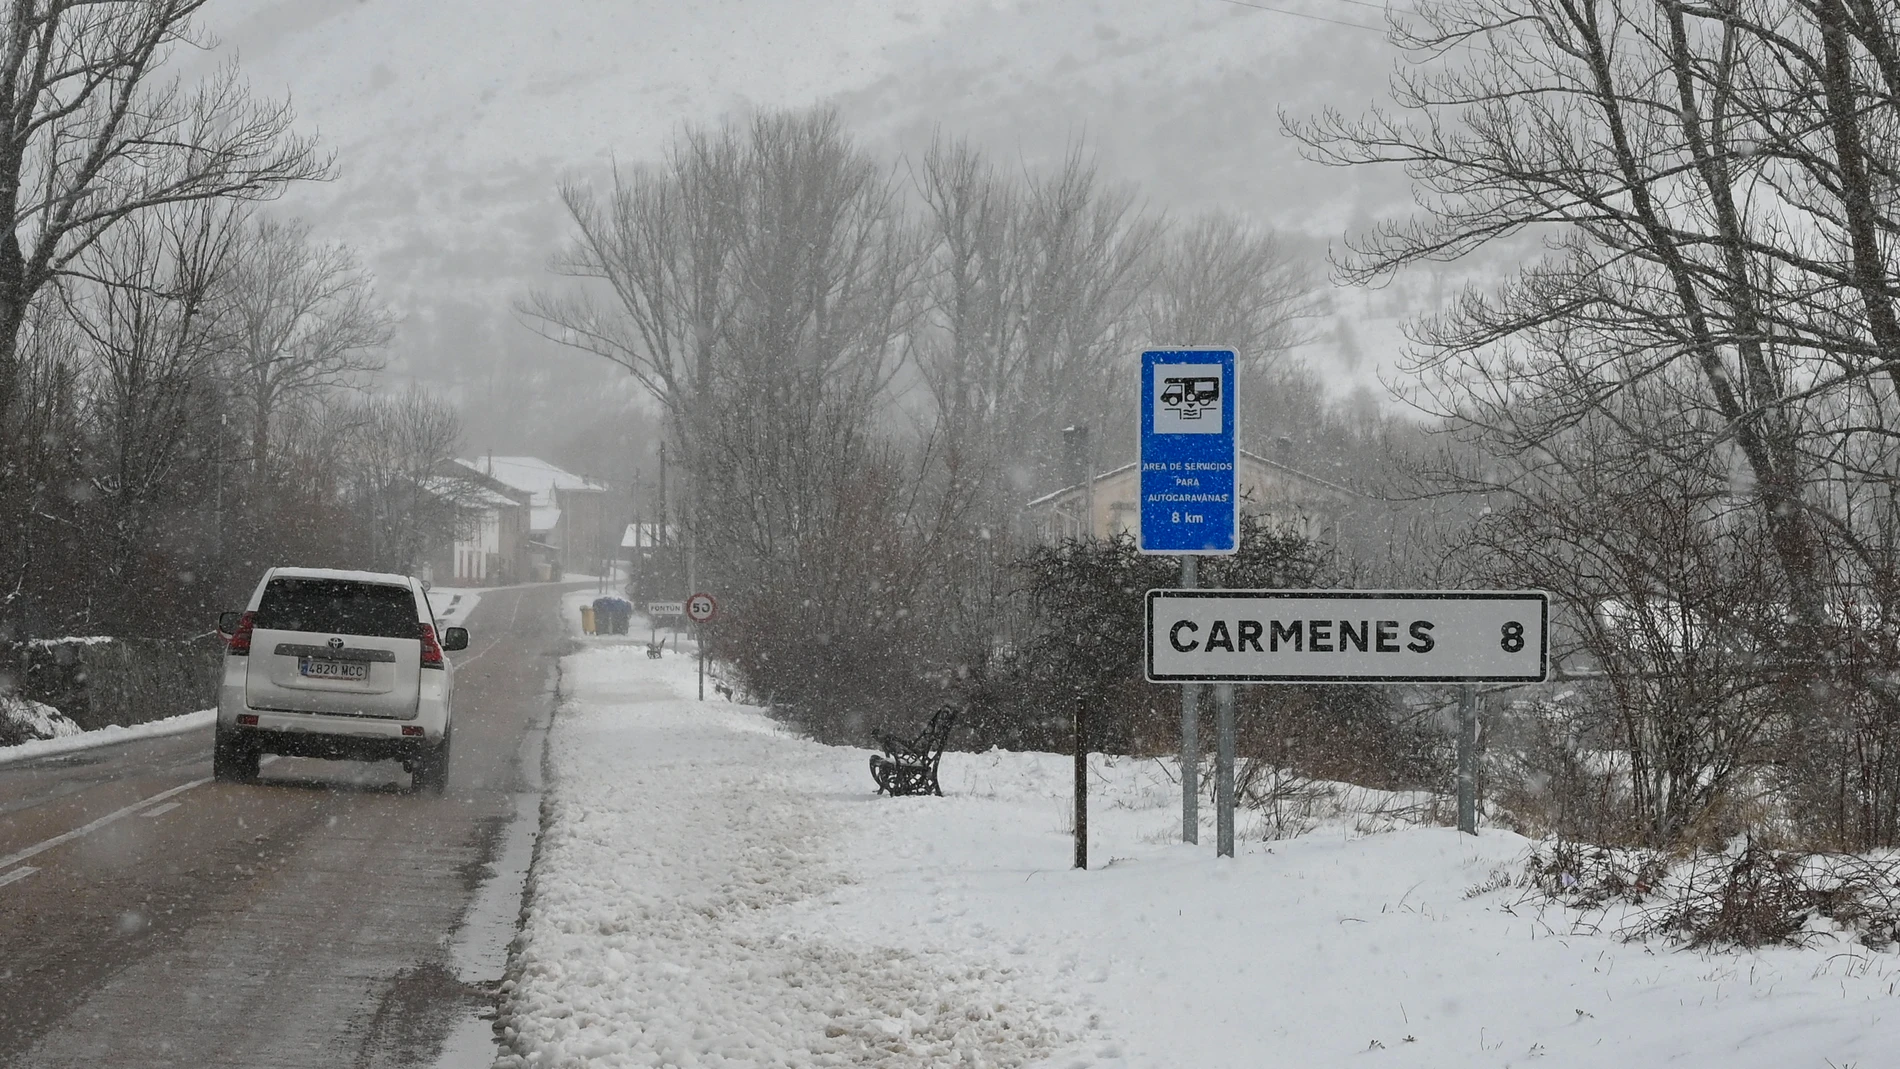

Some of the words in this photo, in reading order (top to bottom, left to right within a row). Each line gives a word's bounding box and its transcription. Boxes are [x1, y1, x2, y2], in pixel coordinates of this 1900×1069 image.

[1143, 463, 1167, 471] AREA
[1170, 463, 1182, 471] DE
[1184, 463, 1233, 471] SERVICIOS
[1176, 478, 1200, 486] PARA
[1147, 494, 1228, 502] AUTOCARAVANAS
[1171, 512, 1180, 523] 8
[1185, 512, 1204, 523] km
[693, 603, 711, 613] 50
[1169, 619, 1435, 653] CARMENES
[1500, 620, 1525, 653] 8
[308, 663, 338, 675] 4820
[341, 665, 363, 677] MCC
